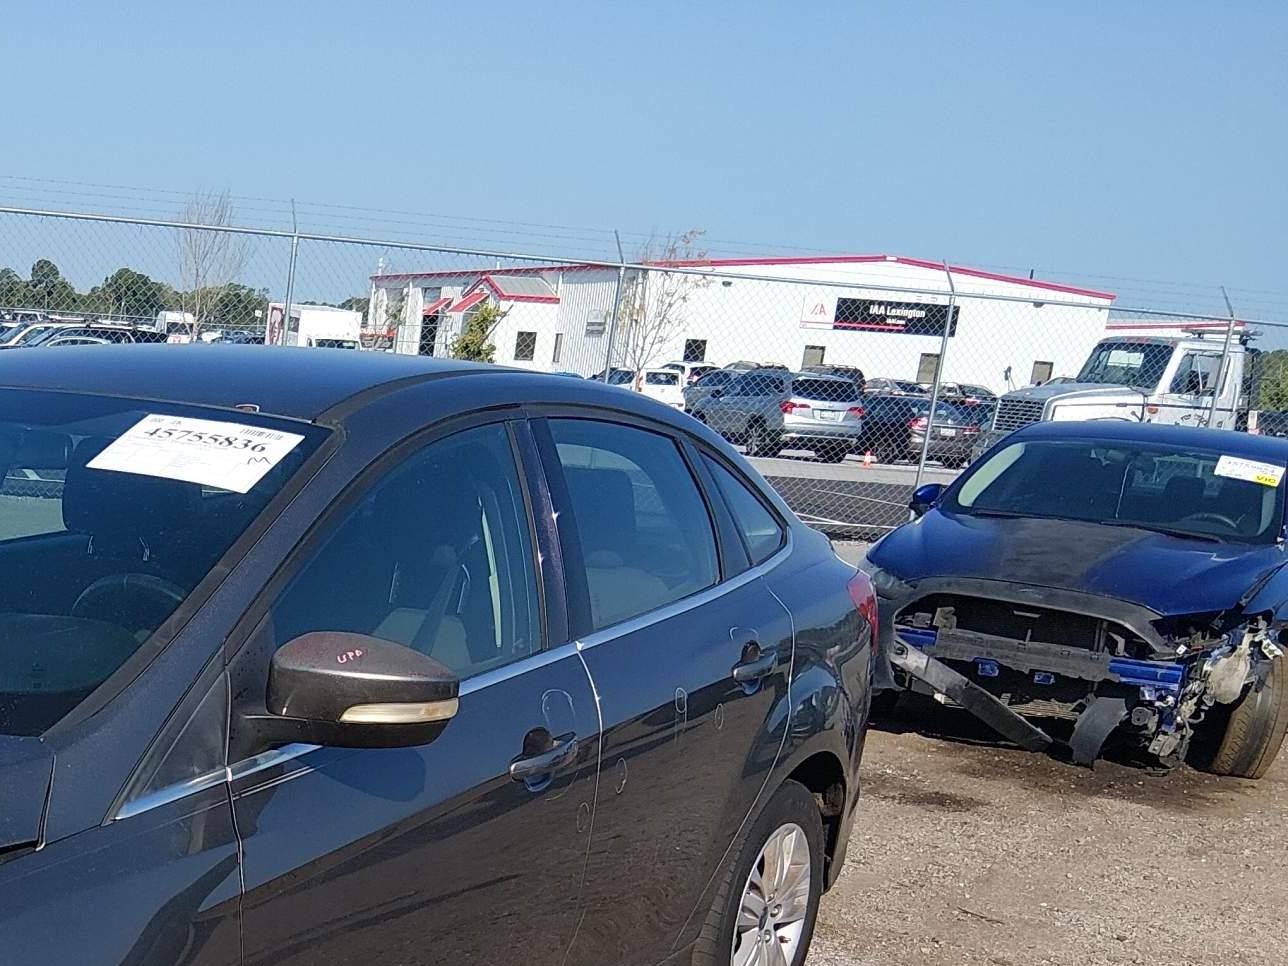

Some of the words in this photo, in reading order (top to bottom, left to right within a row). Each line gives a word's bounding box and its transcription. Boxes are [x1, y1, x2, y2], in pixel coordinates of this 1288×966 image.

[869, 305, 885, 315] IAA
[886, 306, 925, 318] Lexington
[144, 427, 268, 452] 45755836
